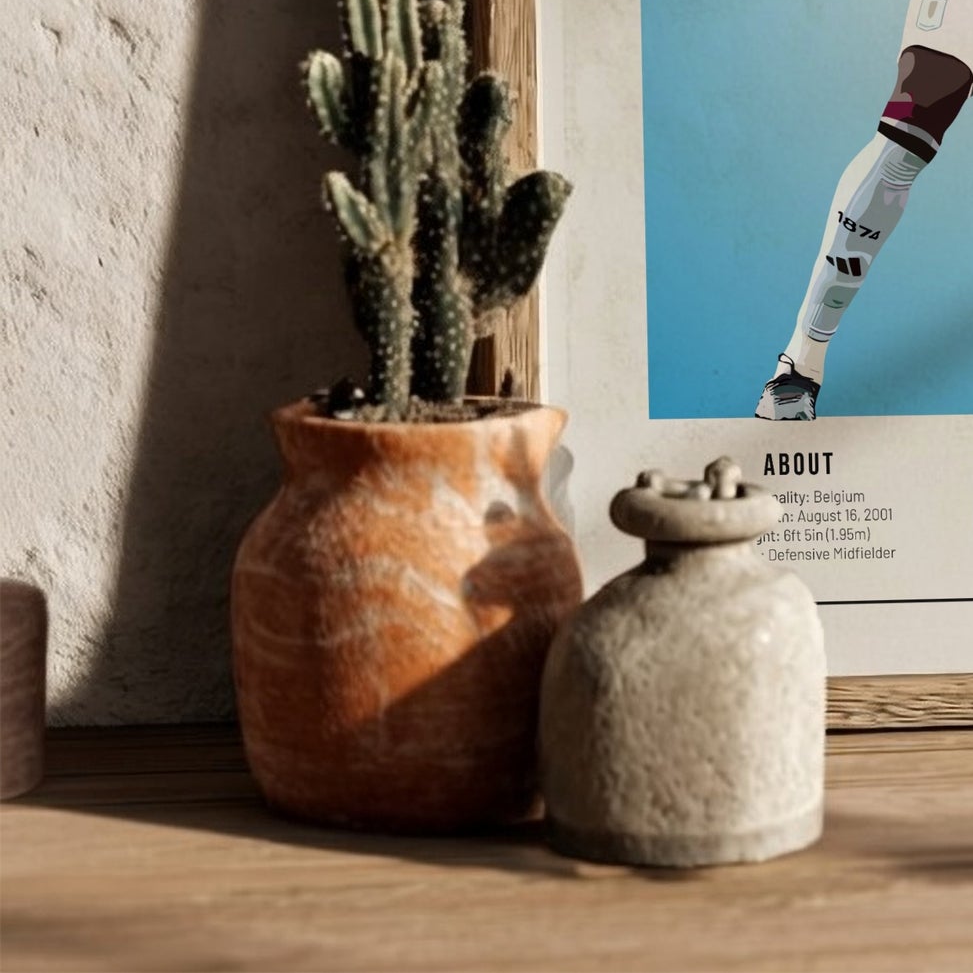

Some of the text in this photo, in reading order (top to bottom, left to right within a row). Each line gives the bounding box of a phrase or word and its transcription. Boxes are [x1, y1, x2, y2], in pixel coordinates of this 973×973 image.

[837, 211, 881, 240] 1874
[764, 452, 834, 476] ABOUT
[813, 490, 865, 506] Belgium
[797, 510, 842, 525] August
[845, 508, 861, 522] 16,
[863, 508, 893, 522] 2001
[783, 529, 801, 542] 6ft
[804, 528, 823, 541] 5in
[825, 526, 871, 542] (1.95m)
[768, 548, 830, 561] Defensive
[833, 546, 896, 559] Midfielder
